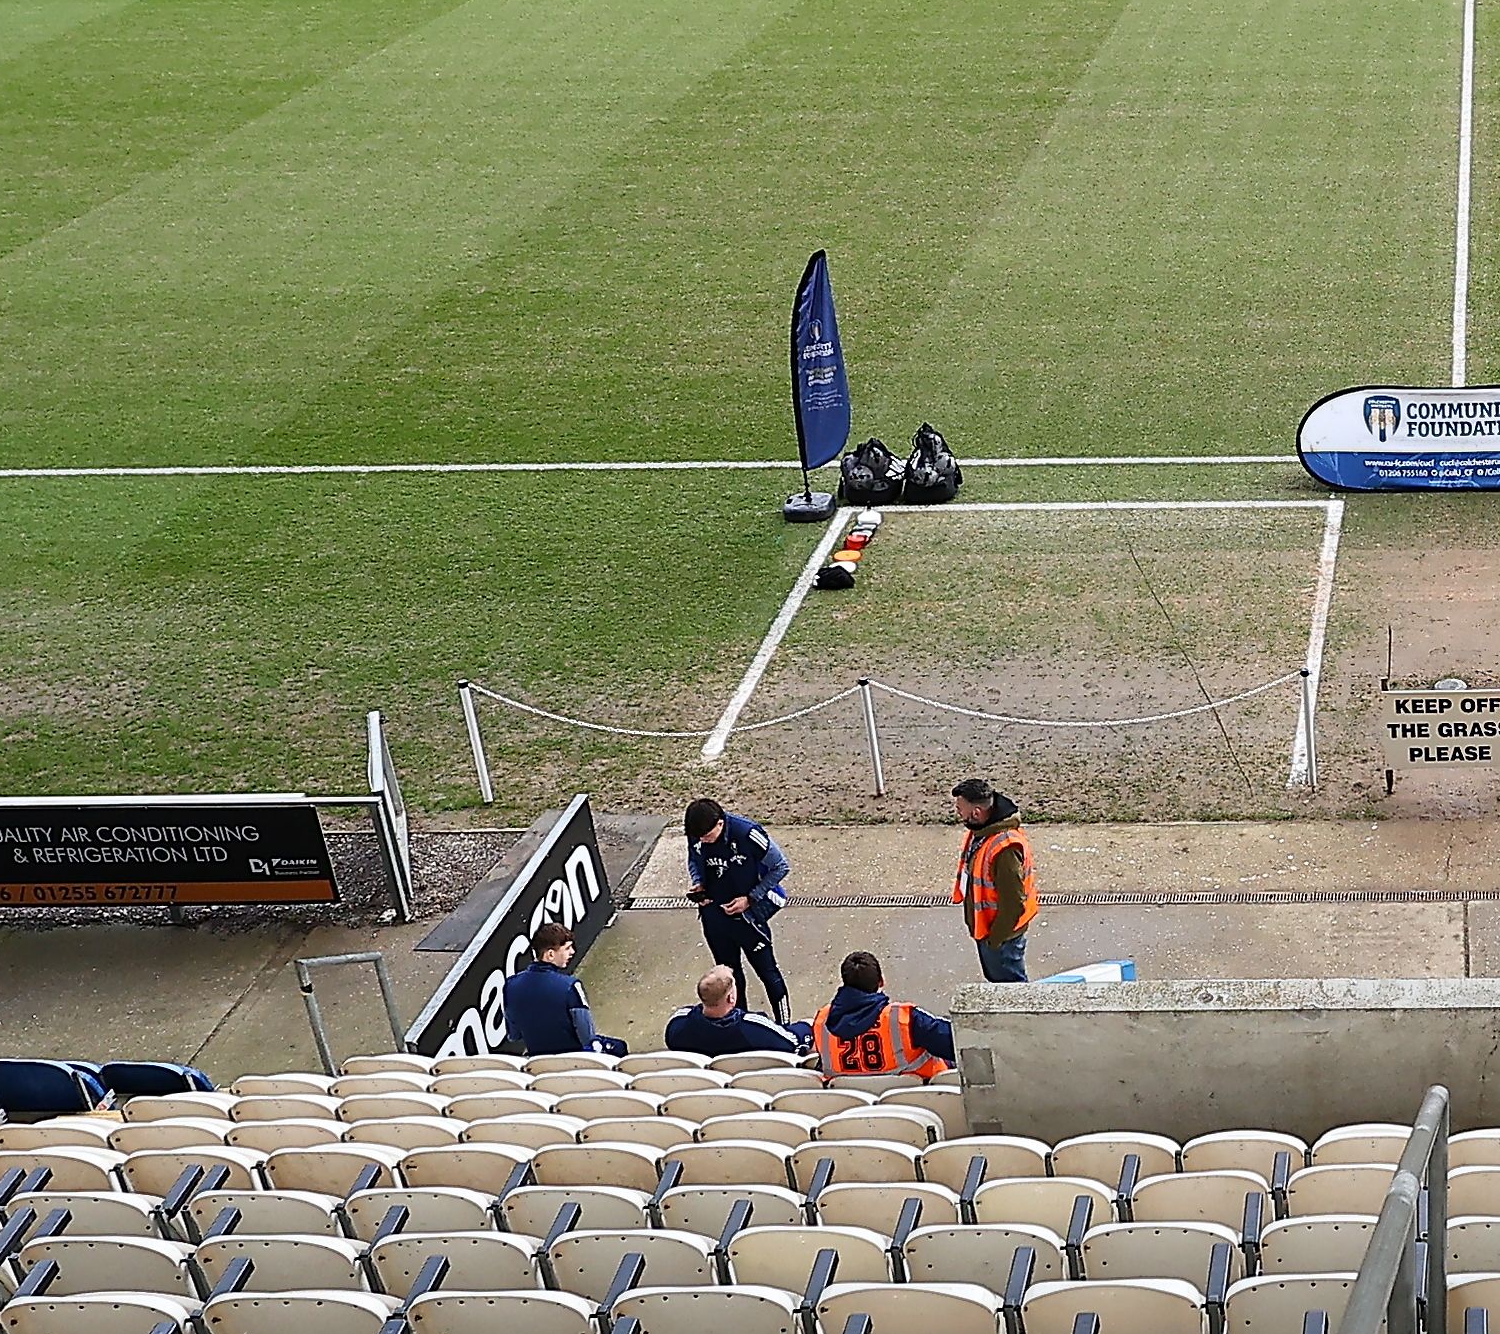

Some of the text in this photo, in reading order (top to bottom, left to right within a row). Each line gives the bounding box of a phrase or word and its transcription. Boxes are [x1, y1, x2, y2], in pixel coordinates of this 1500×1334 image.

[1394, 697, 1500, 715] KEEP OFF
[1386, 722, 1430, 739] THE
[1408, 745, 1492, 763] PLEASE
[58, 826, 92, 843] AIR
[95, 825, 260, 843] CONDITIONING
[13, 845, 228, 864] & REFRIGERATION LTD
[282, 858, 318, 867] DAIKIN
[33, 885, 97, 902] 01255
[103, 884, 178, 901] 672777
[836, 1033, 886, 1072] 28
